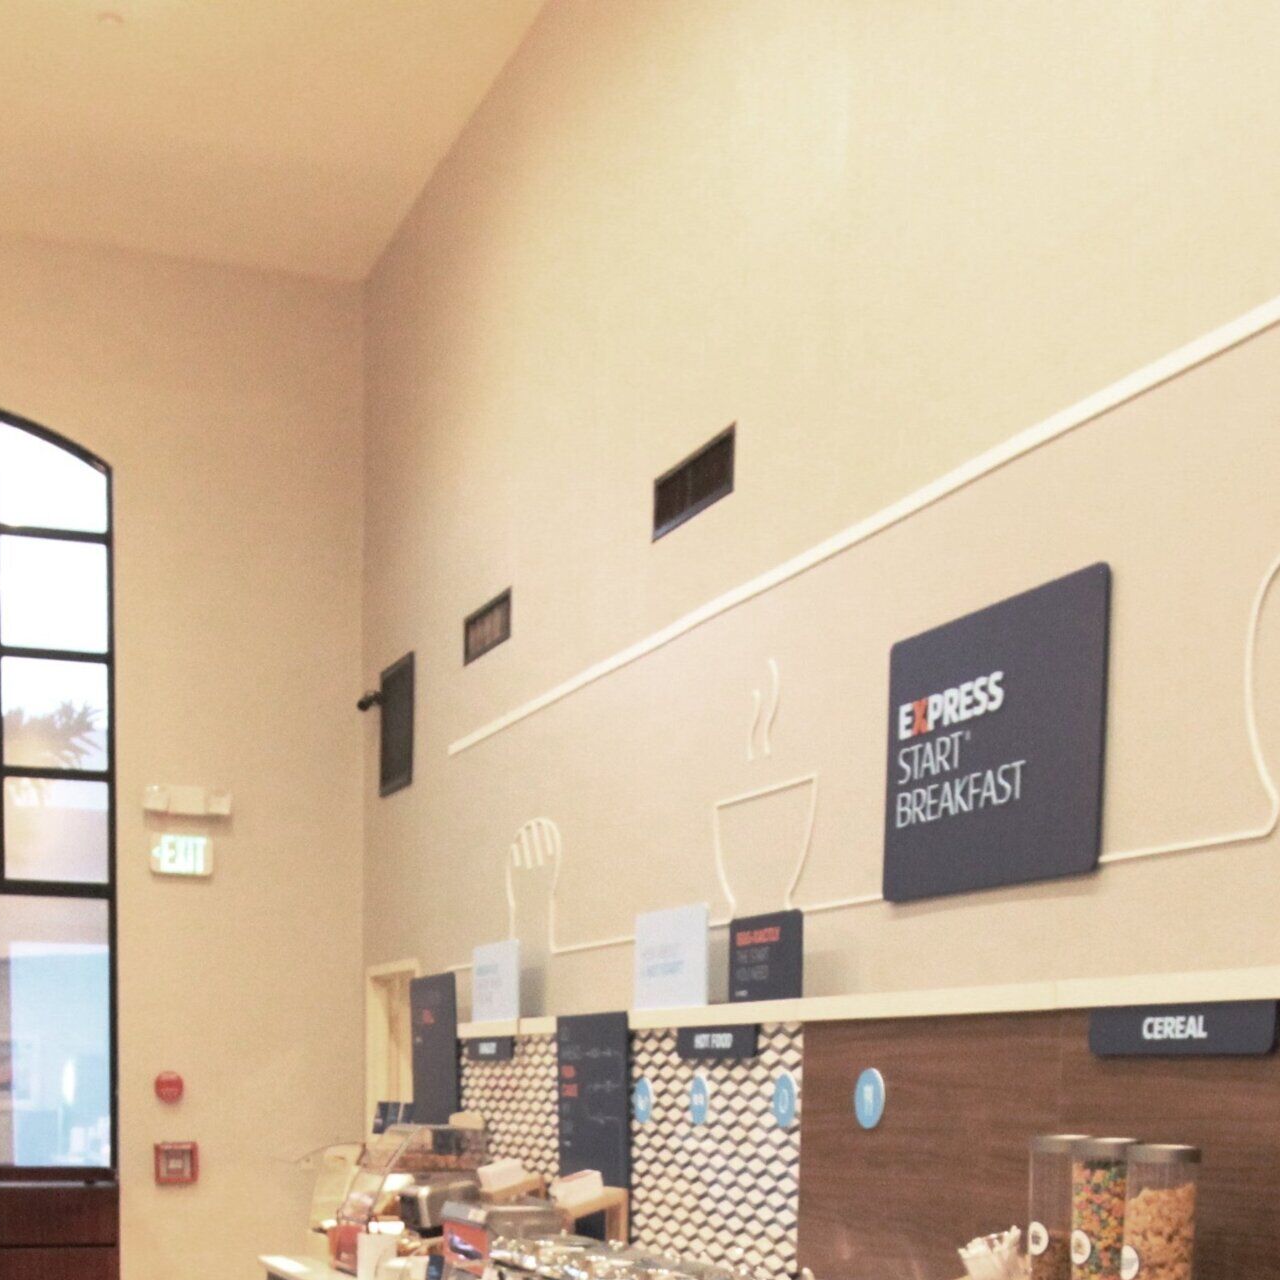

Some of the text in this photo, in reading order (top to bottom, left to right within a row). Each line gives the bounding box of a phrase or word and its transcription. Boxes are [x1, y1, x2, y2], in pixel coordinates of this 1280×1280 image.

[899, 671, 1005, 740] EXPRESS
[896, 760, 1026, 828] BREAKFAST
[161, 834, 207, 874] EXIT
[1143, 1015, 1208, 1040] CEREAL
